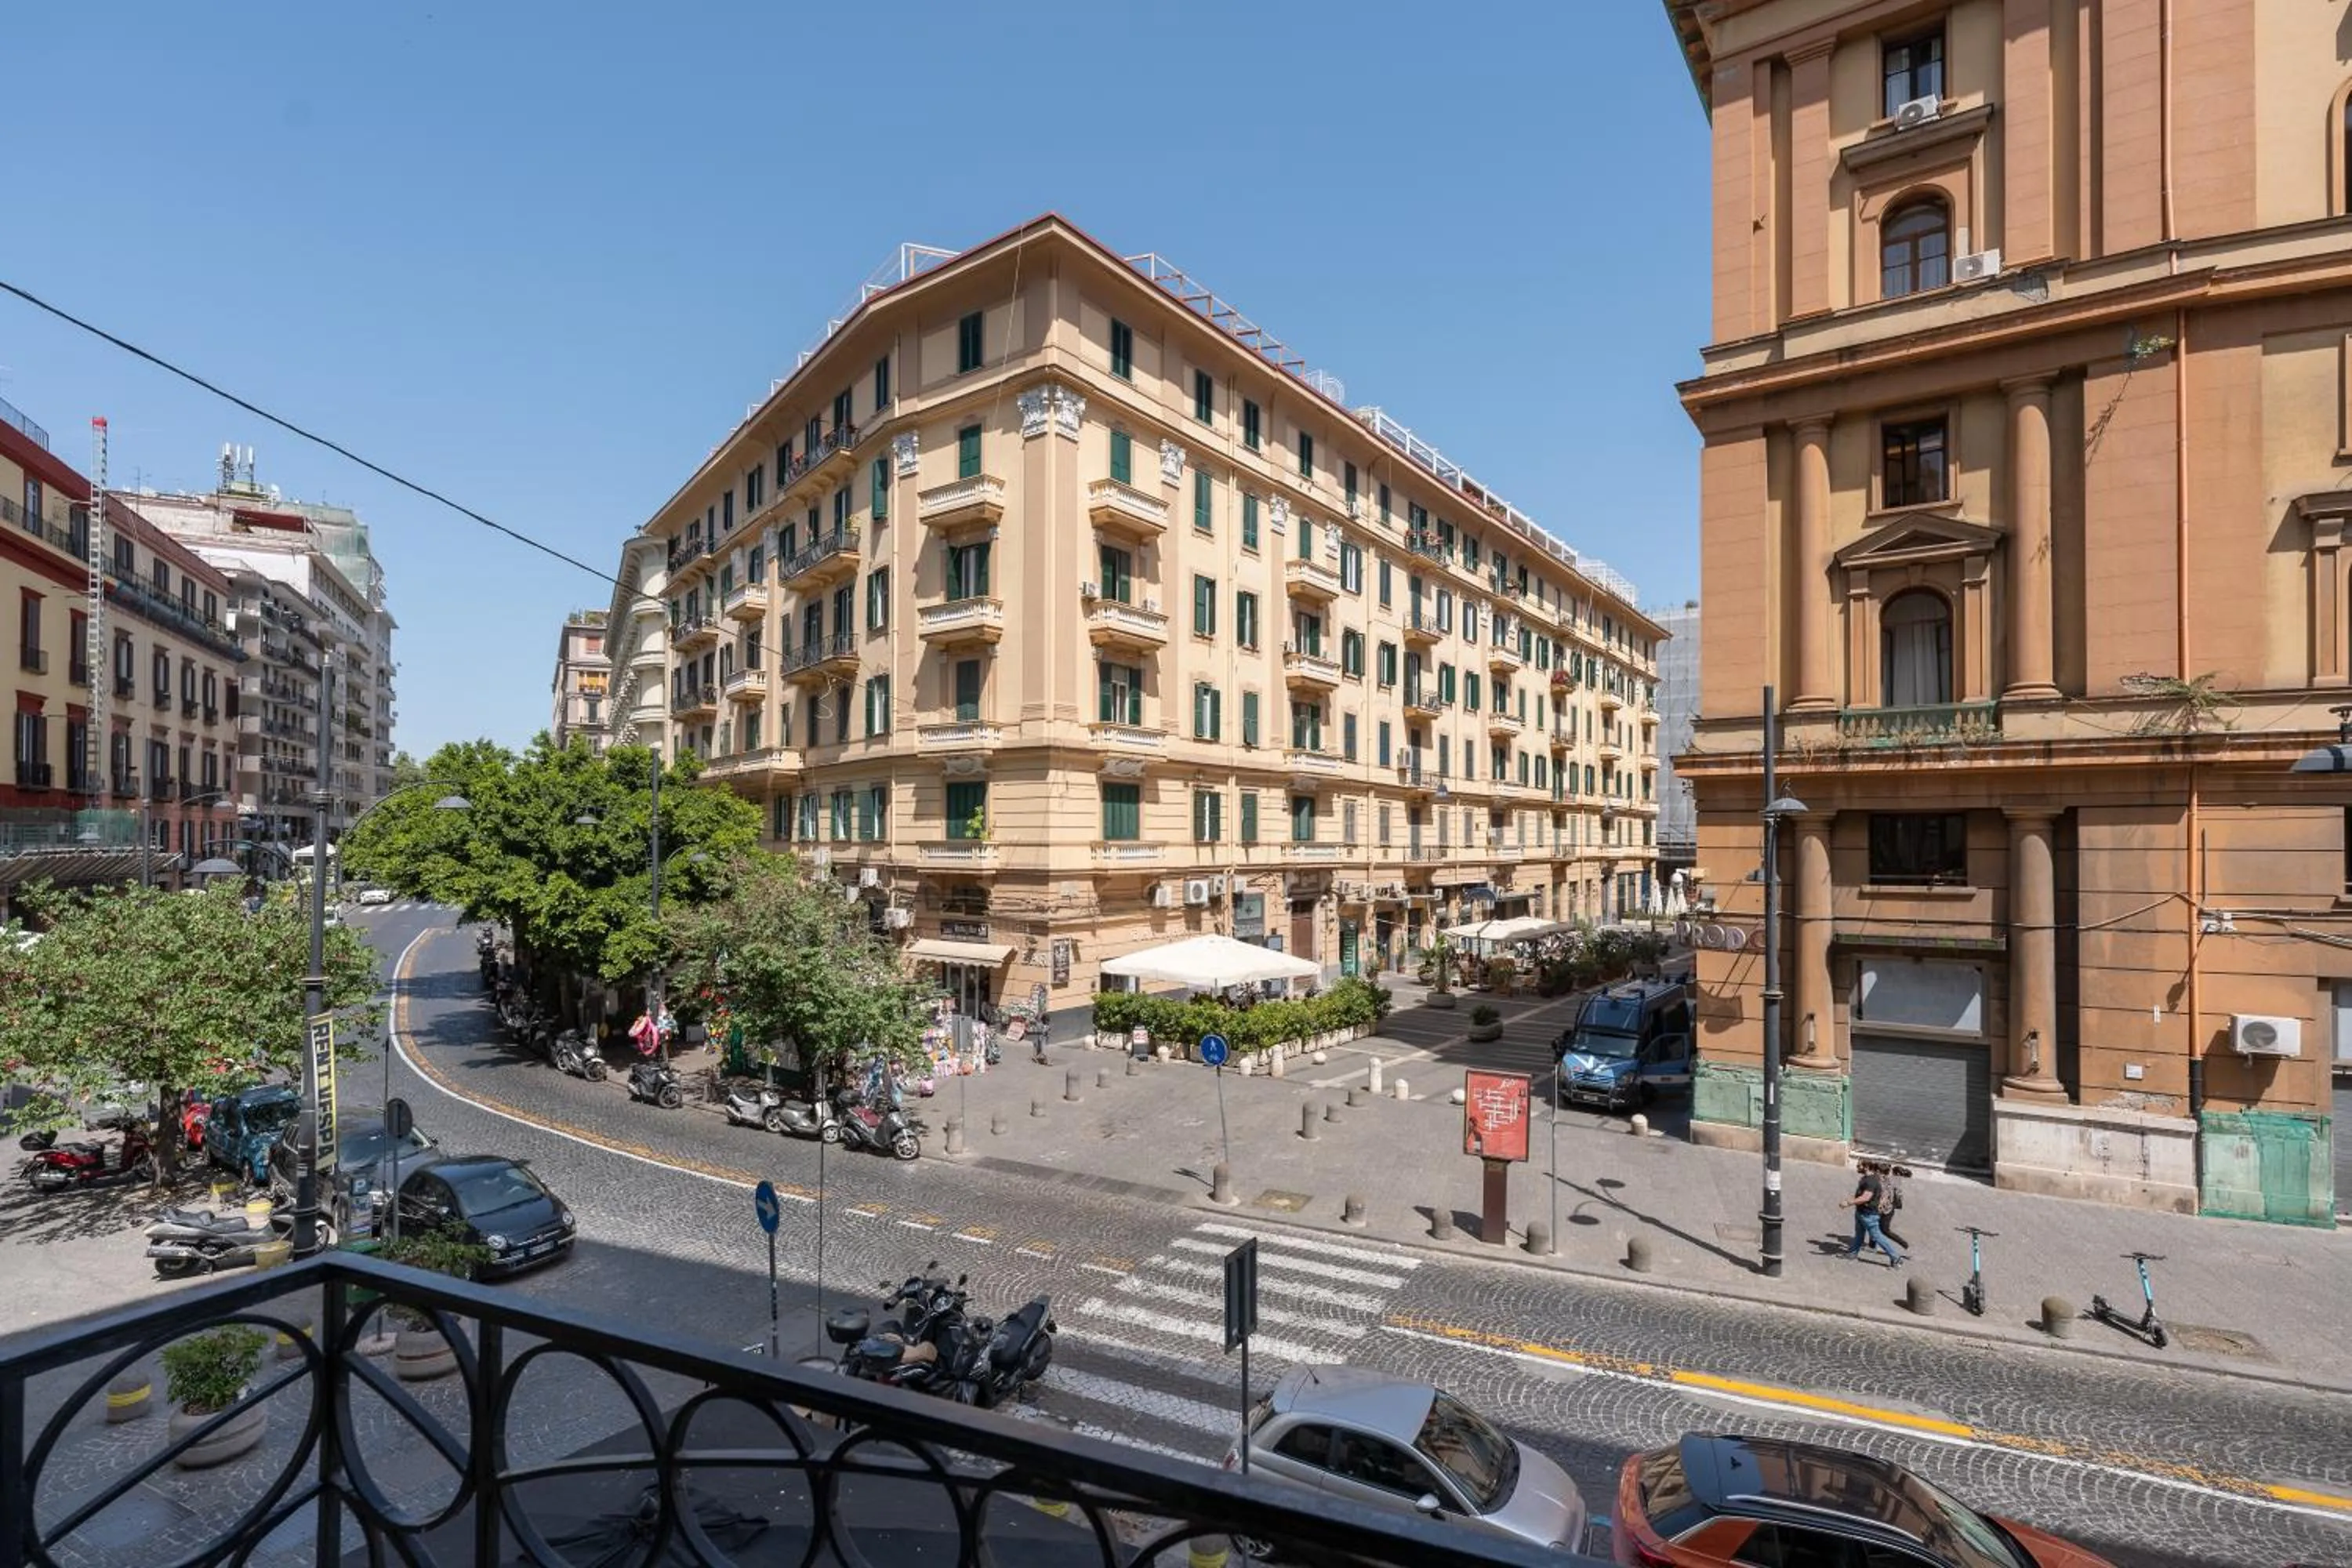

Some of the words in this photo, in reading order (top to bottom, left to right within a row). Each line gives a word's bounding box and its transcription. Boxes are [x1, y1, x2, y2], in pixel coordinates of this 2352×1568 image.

[314, 1022, 332, 1079] RENT
[318, 1087, 335, 1160] VESPA
[353, 1178, 367, 1193] P
